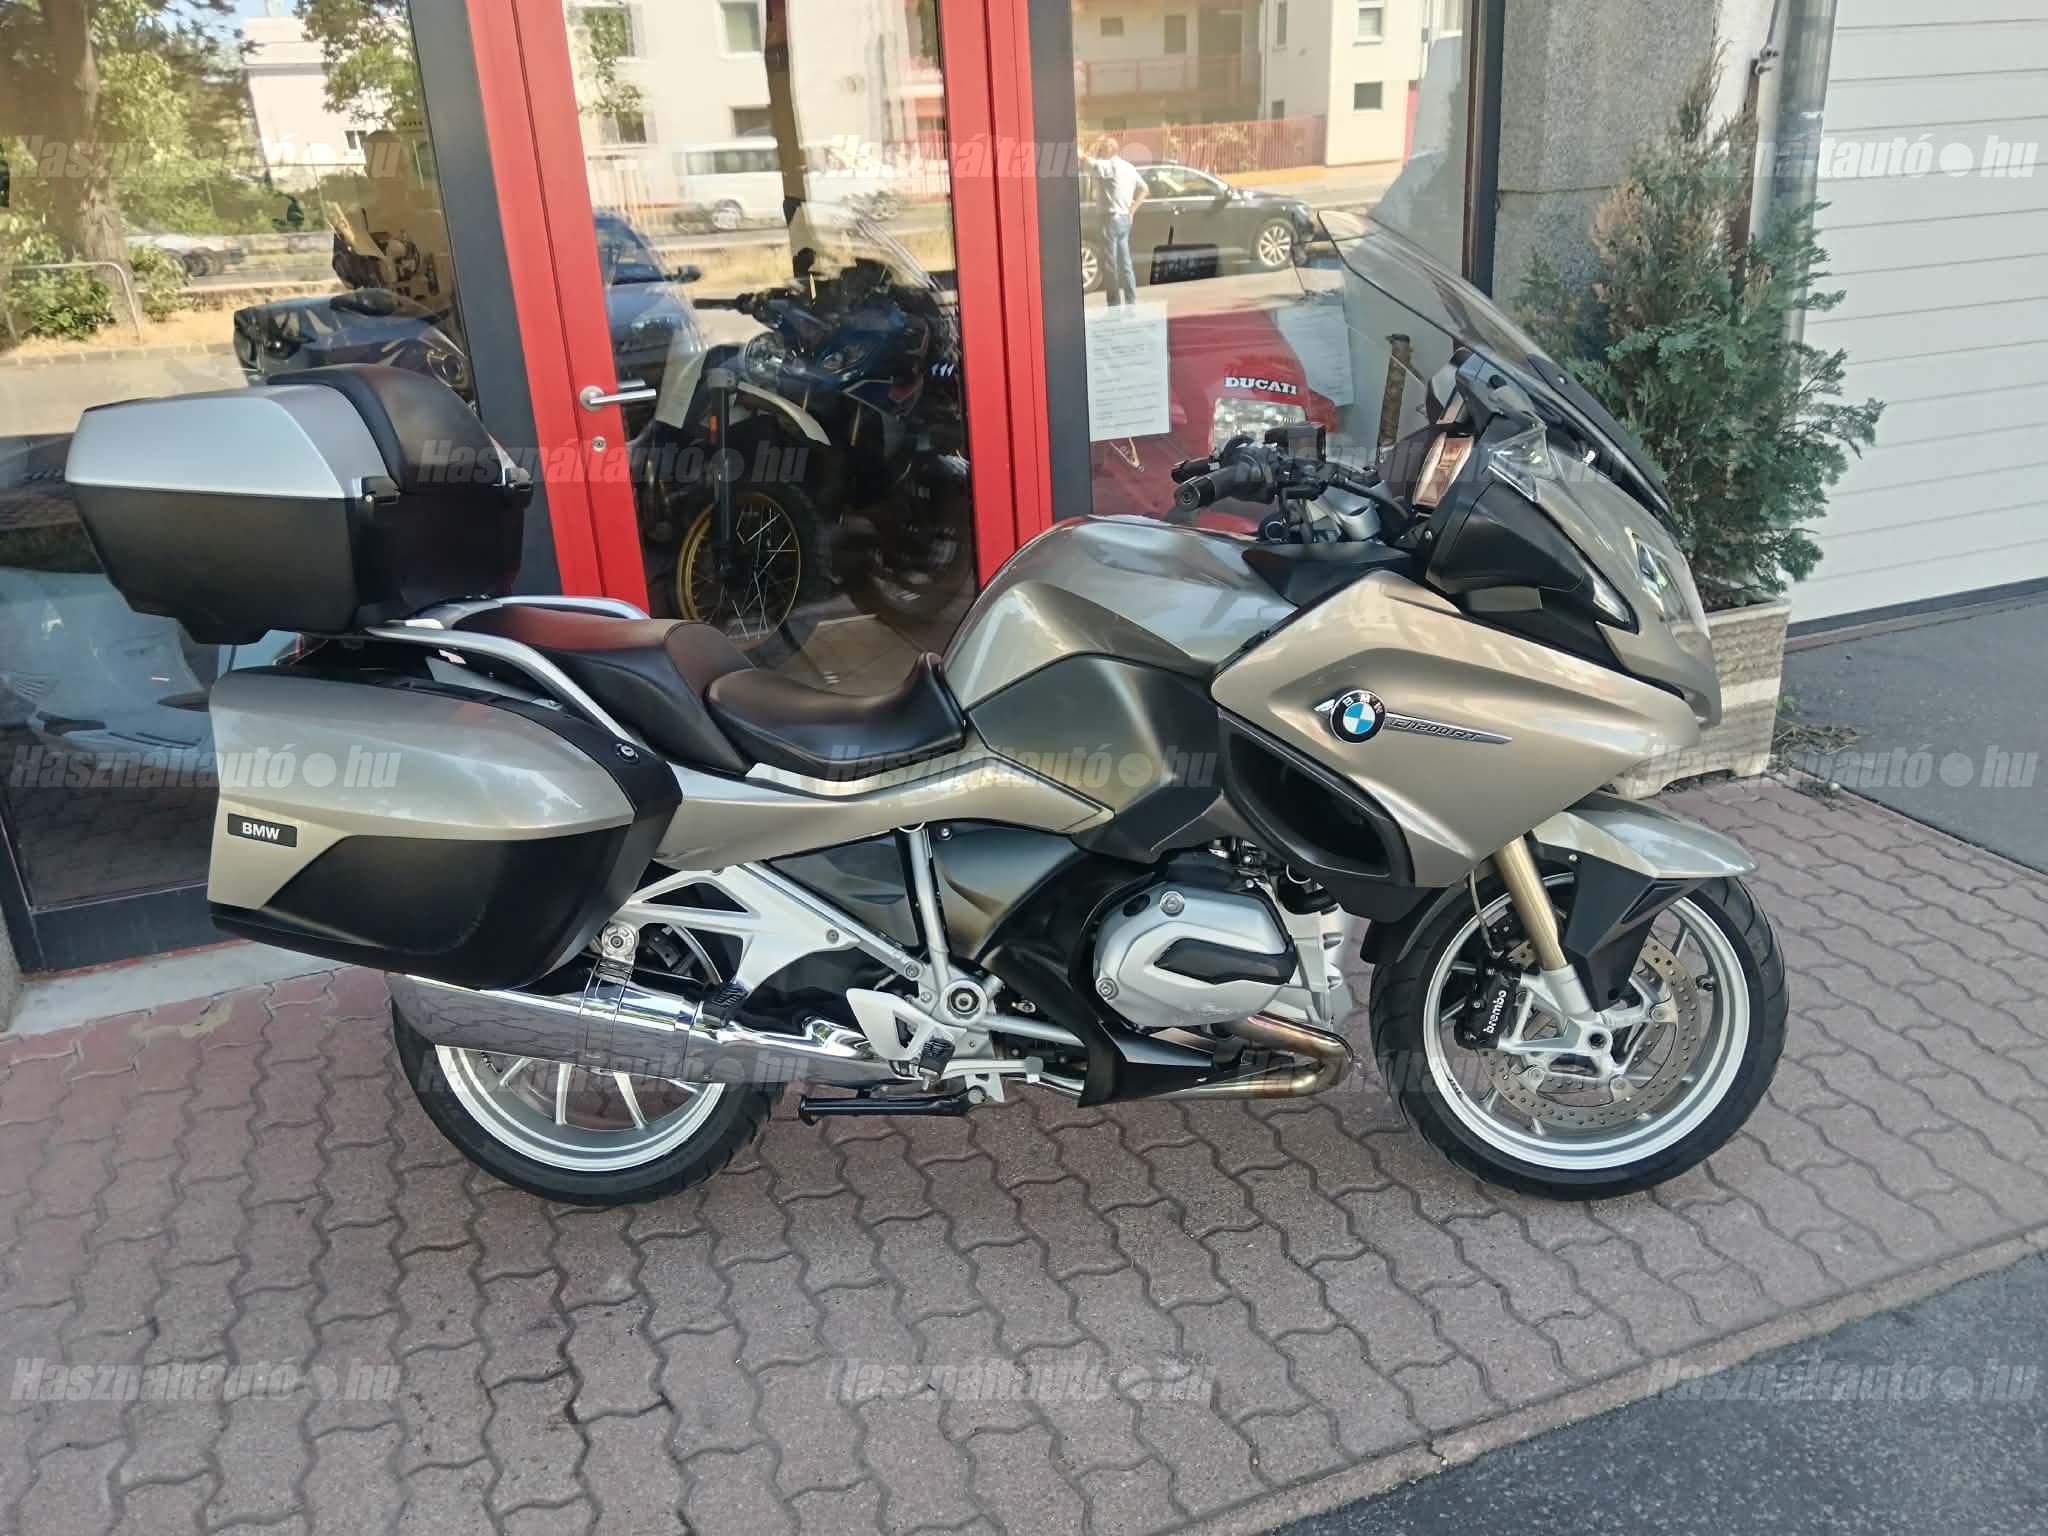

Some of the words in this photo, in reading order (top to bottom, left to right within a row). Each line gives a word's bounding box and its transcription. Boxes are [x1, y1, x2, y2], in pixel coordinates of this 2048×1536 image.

[1225, 377, 1297, 395] DUCATI
[1343, 692, 1384, 714] BMW
[242, 822, 280, 840] BMW
[1483, 990, 1507, 1034] brembo
